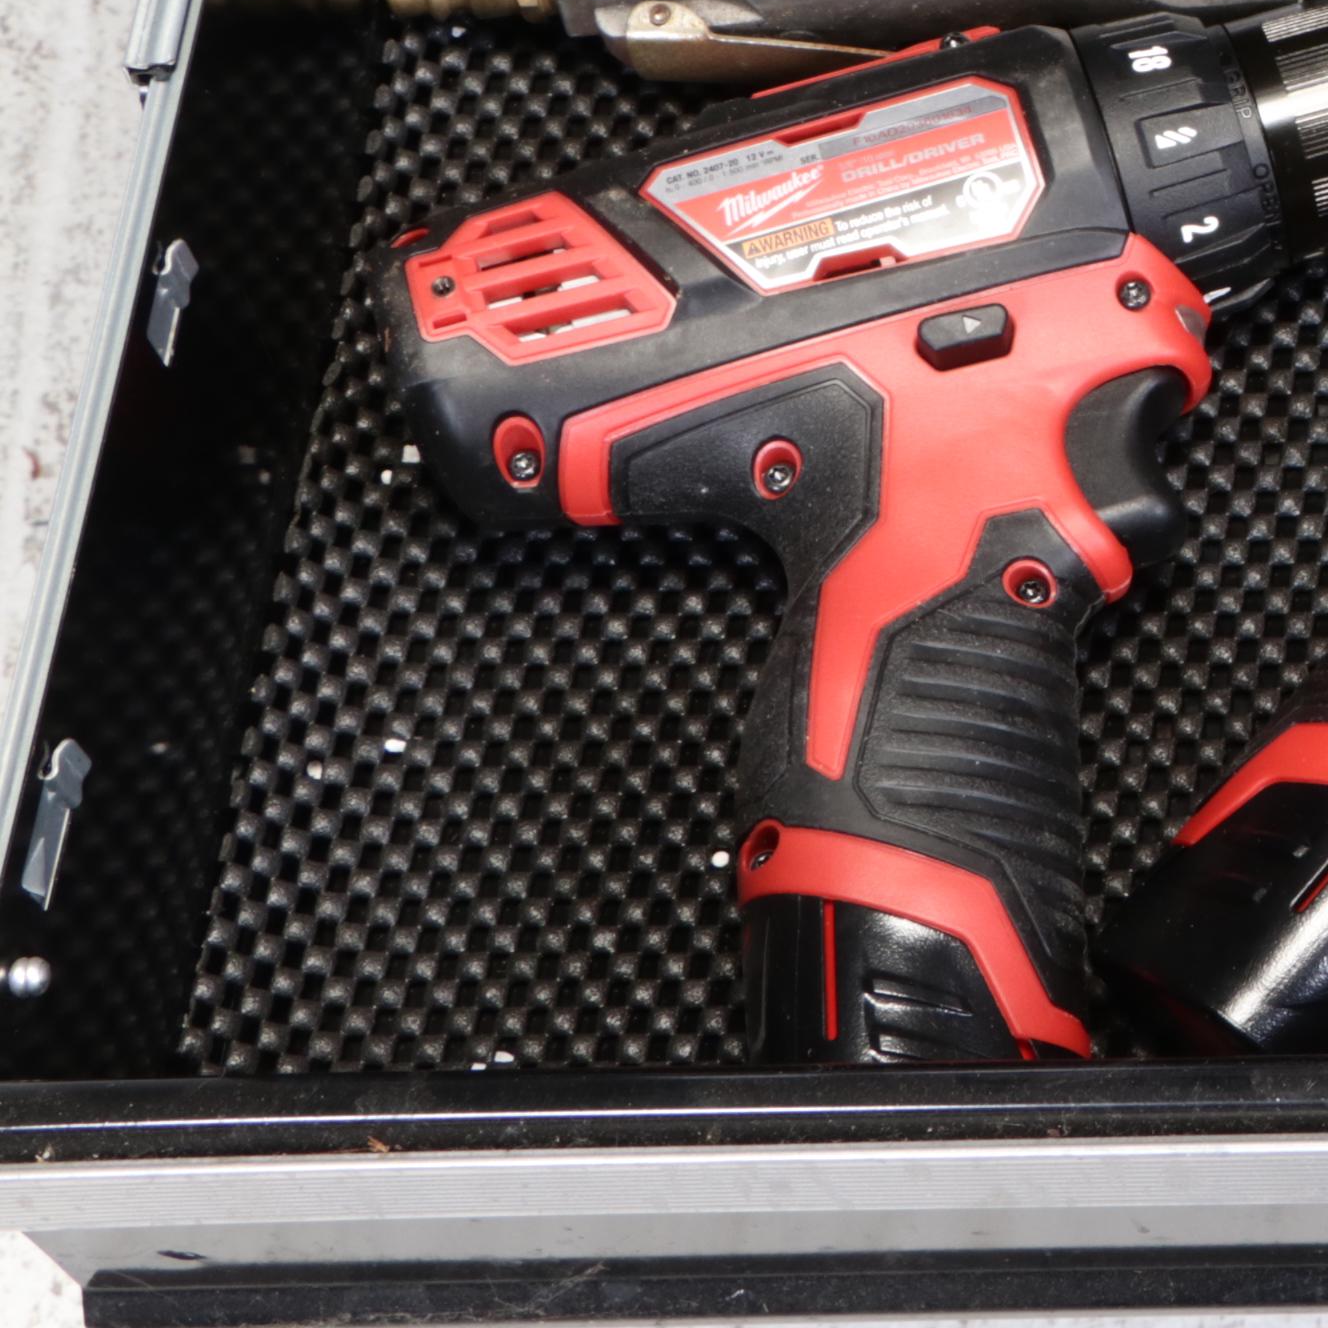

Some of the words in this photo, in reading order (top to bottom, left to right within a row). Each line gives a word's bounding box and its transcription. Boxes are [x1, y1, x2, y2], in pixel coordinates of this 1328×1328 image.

[1128, 46, 1172, 73] 18
[842, 133, 986, 183] DRILL/DRIVER
[718, 167, 822, 228] Milwaukee
[758, 222, 829, 253] WARNING
[921, 195, 932, 207] of
[1180, 216, 1220, 243] 2
